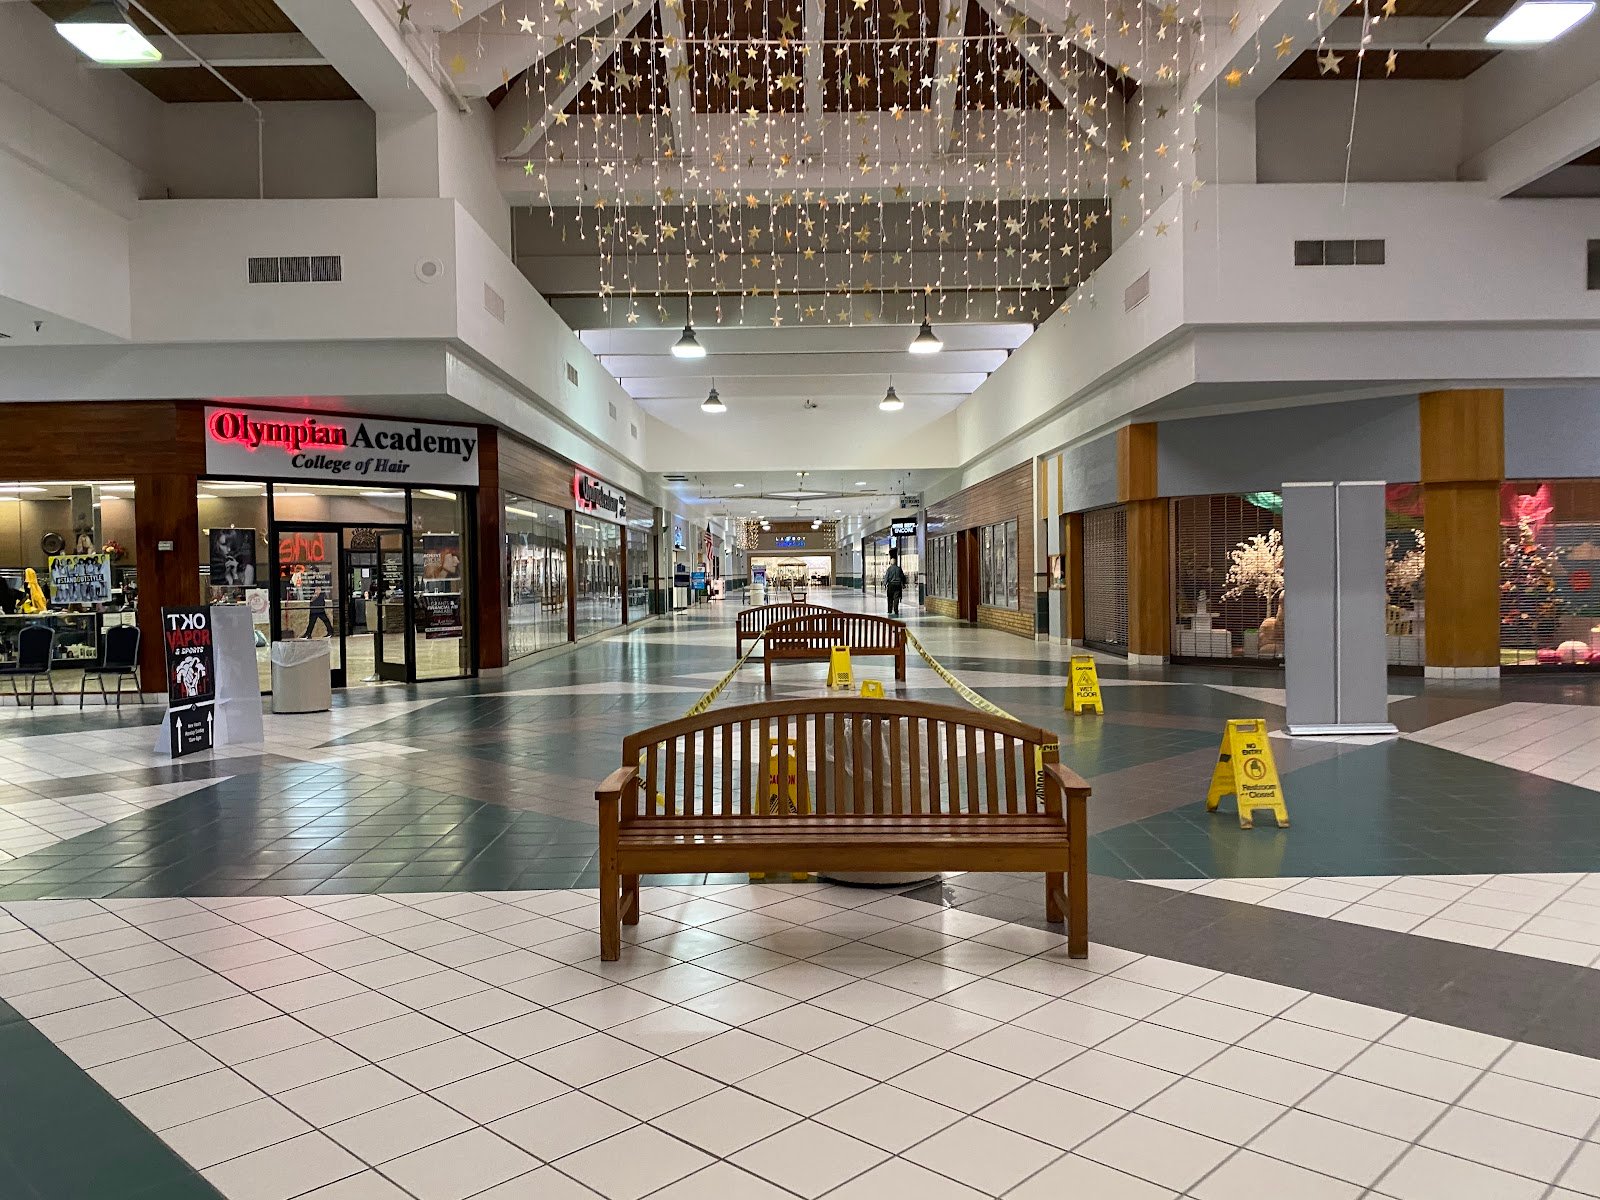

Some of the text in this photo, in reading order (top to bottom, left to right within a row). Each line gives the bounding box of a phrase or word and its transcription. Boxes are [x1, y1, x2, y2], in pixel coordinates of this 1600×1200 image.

[210, 411, 477, 462] Olympian Academy
[291, 454, 410, 475] College of Hair
[166, 629, 211, 649] VAPOR
[1242, 784, 1277, 792] Restroom
[1249, 791, 1275, 799] Closed
